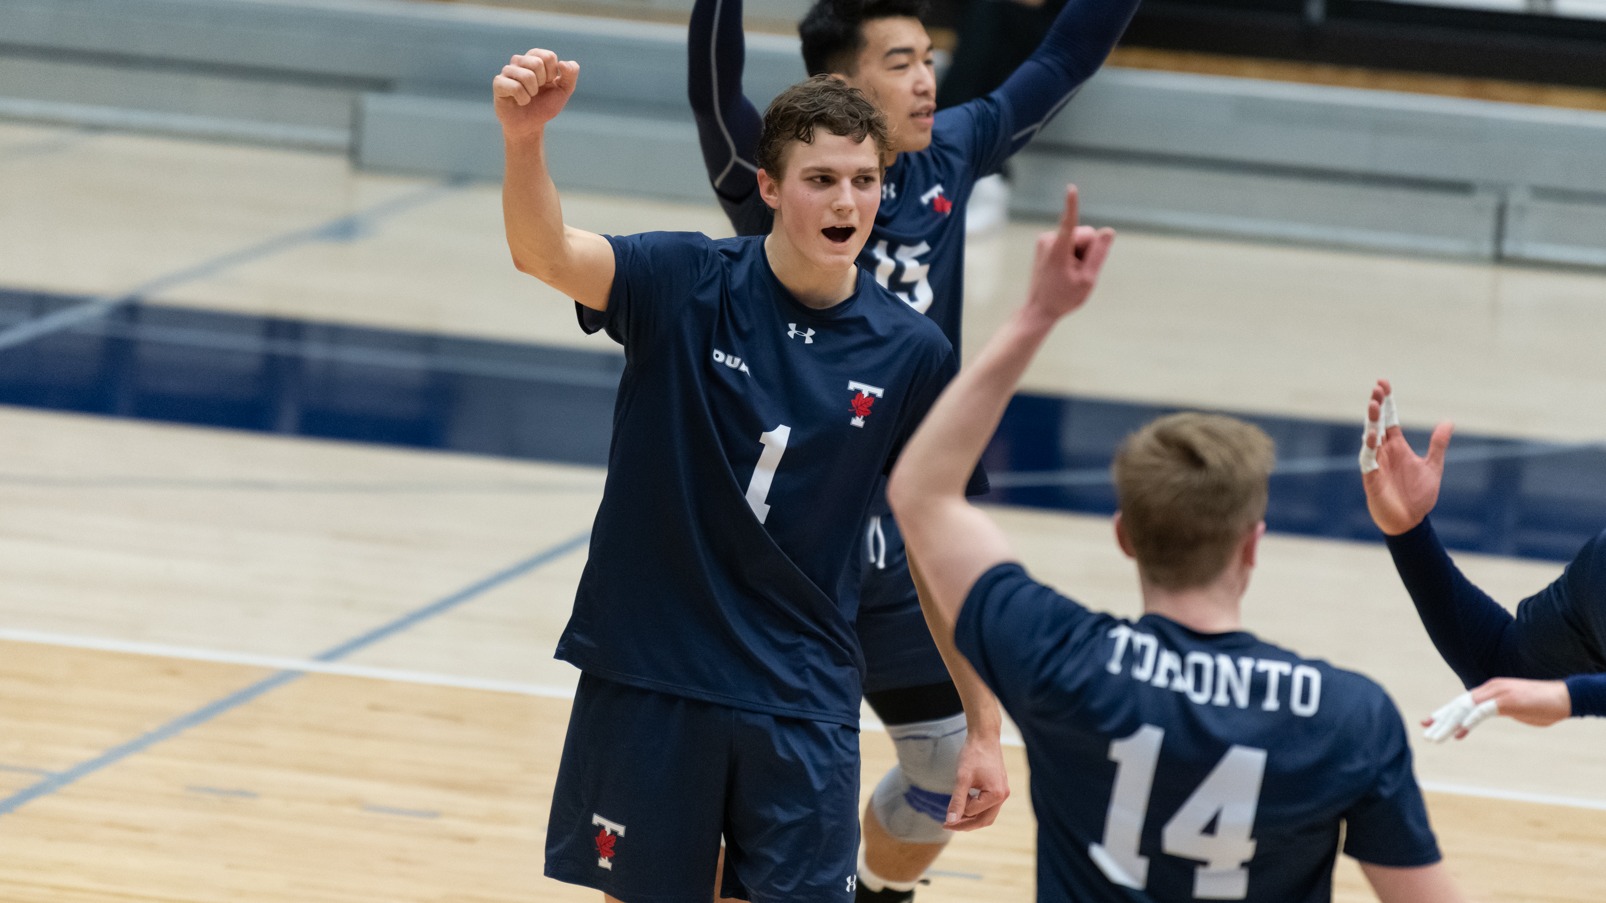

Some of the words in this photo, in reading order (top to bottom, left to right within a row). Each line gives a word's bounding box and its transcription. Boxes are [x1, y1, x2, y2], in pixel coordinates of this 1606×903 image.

[872, 240, 934, 315] 15
[847, 380, 885, 428] T
[745, 424, 791, 525] 1
[1105, 624, 1322, 717] TORONTO
[592, 812, 627, 872] T
[1088, 723, 1268, 900] 14
